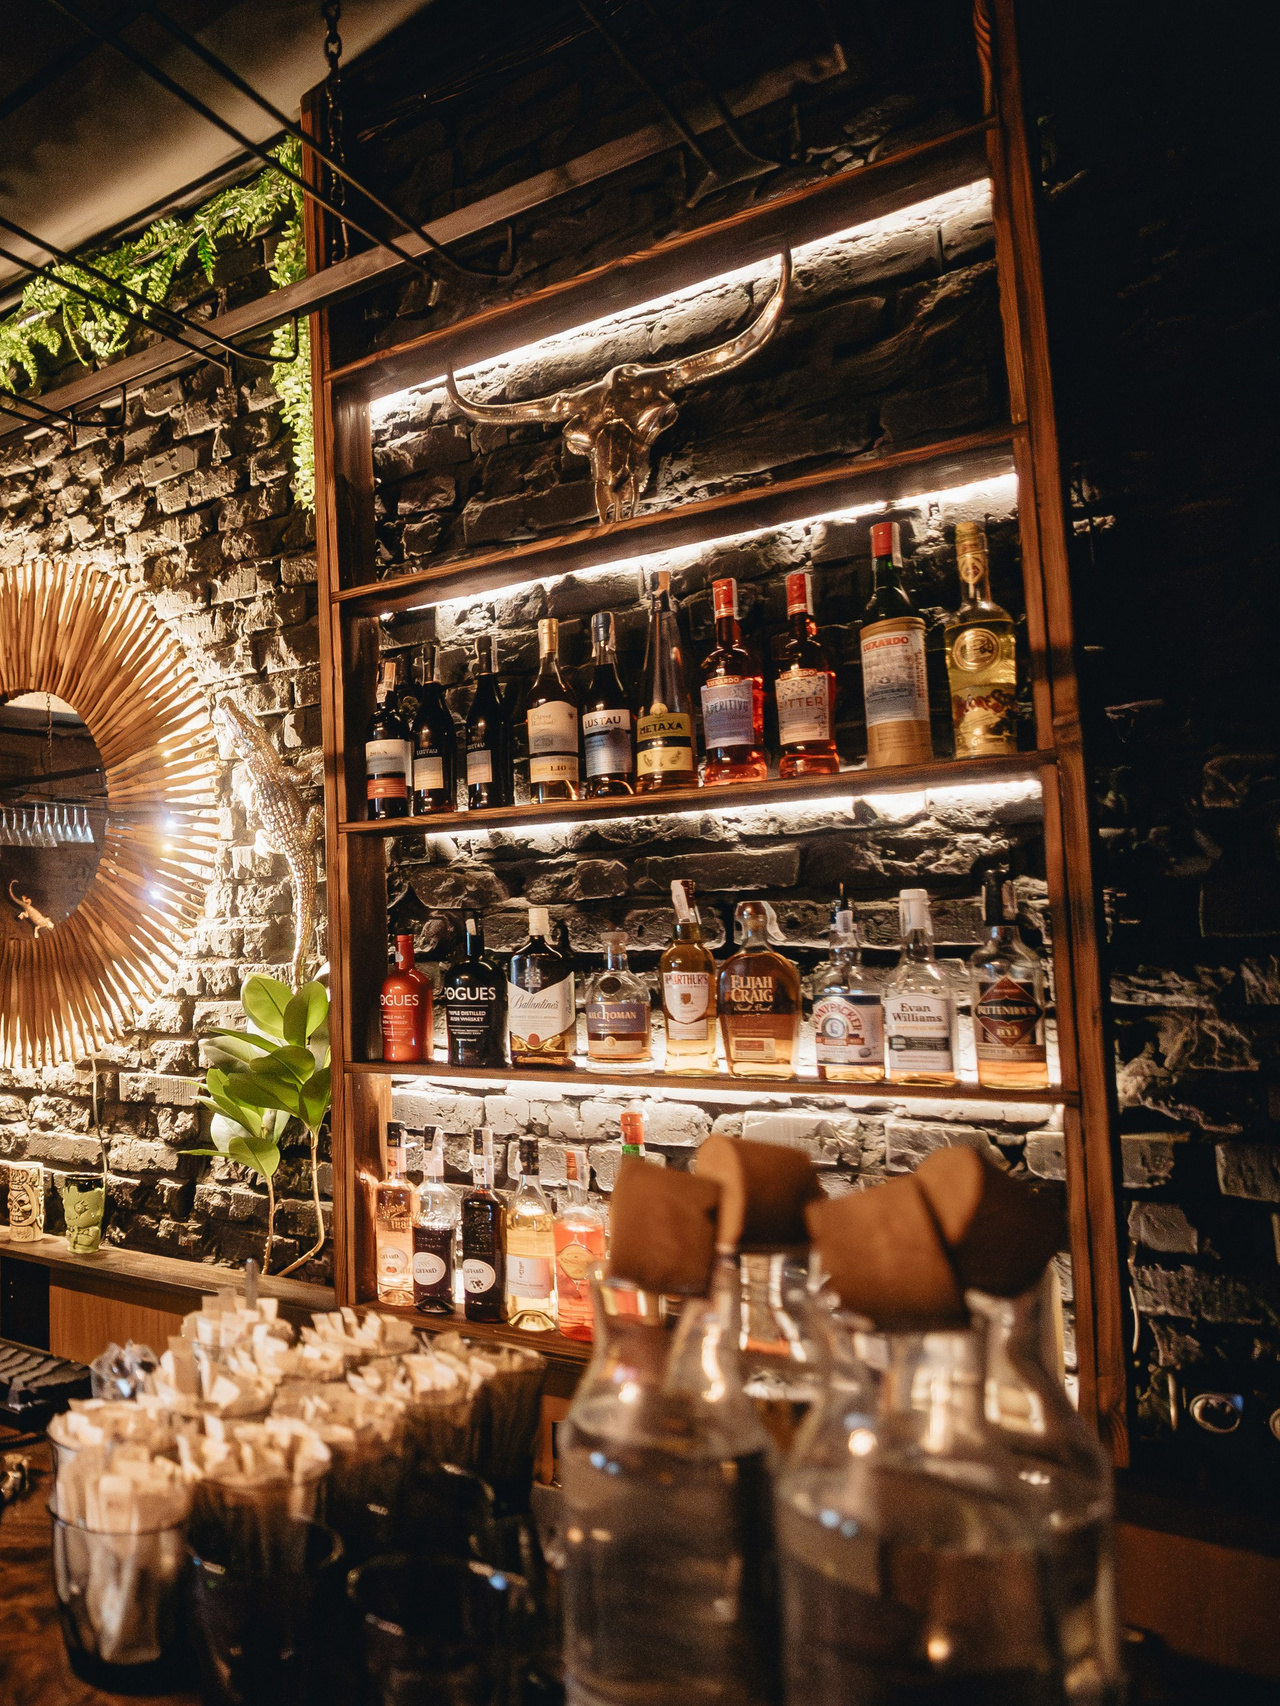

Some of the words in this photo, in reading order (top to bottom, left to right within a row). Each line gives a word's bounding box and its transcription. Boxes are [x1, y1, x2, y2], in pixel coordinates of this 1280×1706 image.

[863, 636, 909, 651] LUXARDO
[584, 715, 622, 729] LUSTAU
[639, 721, 683, 735] METAXA
[730, 975, 773, 989] ELIJAH
[380, 994, 419, 1006] OGUES
[444, 987, 496, 1001] OGUES
[730, 988, 774, 1004] CRAIG
[510, 994, 559, 1010] Ballantine's
[900, 1002, 932, 1012] Evan
[892, 1012, 943, 1023] Williams
